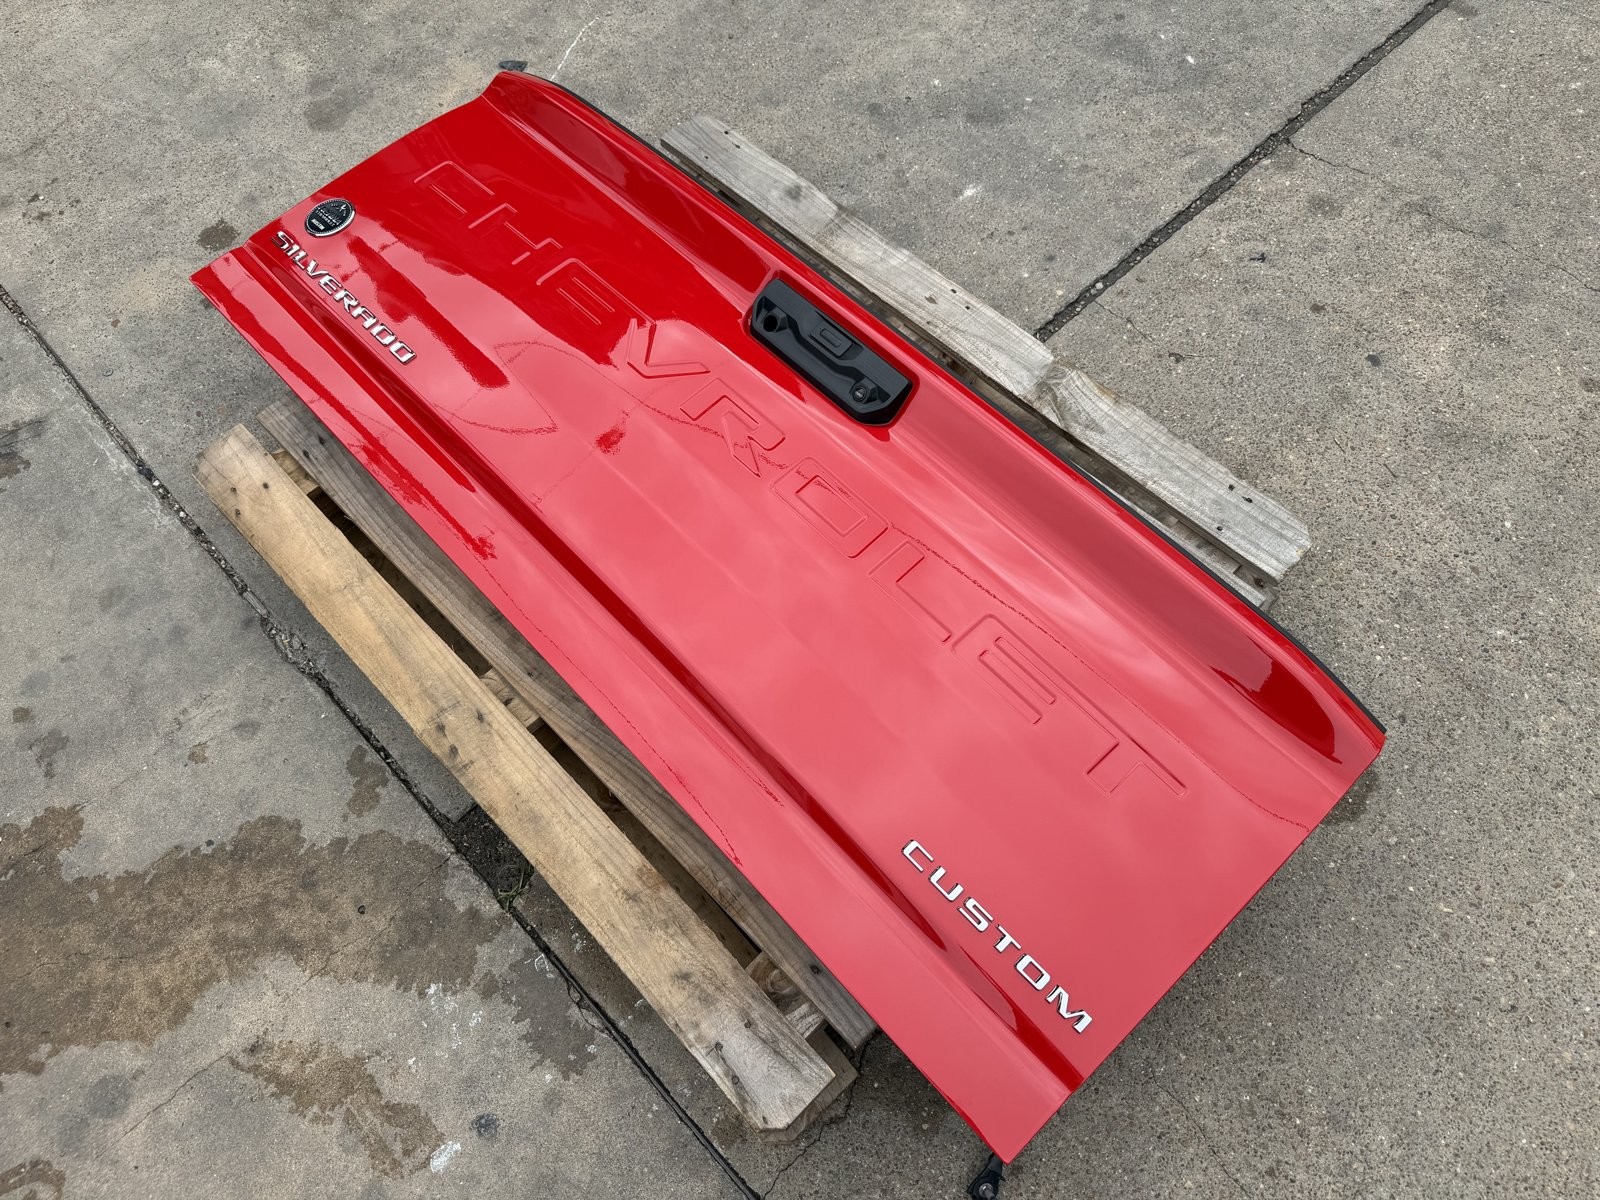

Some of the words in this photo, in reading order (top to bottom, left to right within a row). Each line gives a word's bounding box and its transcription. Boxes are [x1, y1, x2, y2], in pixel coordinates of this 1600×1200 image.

[271, 230, 417, 365] SILVERADO
[413, 160, 1187, 797] CHEVROLET
[901, 839, 1093, 1034] CUSTOM
